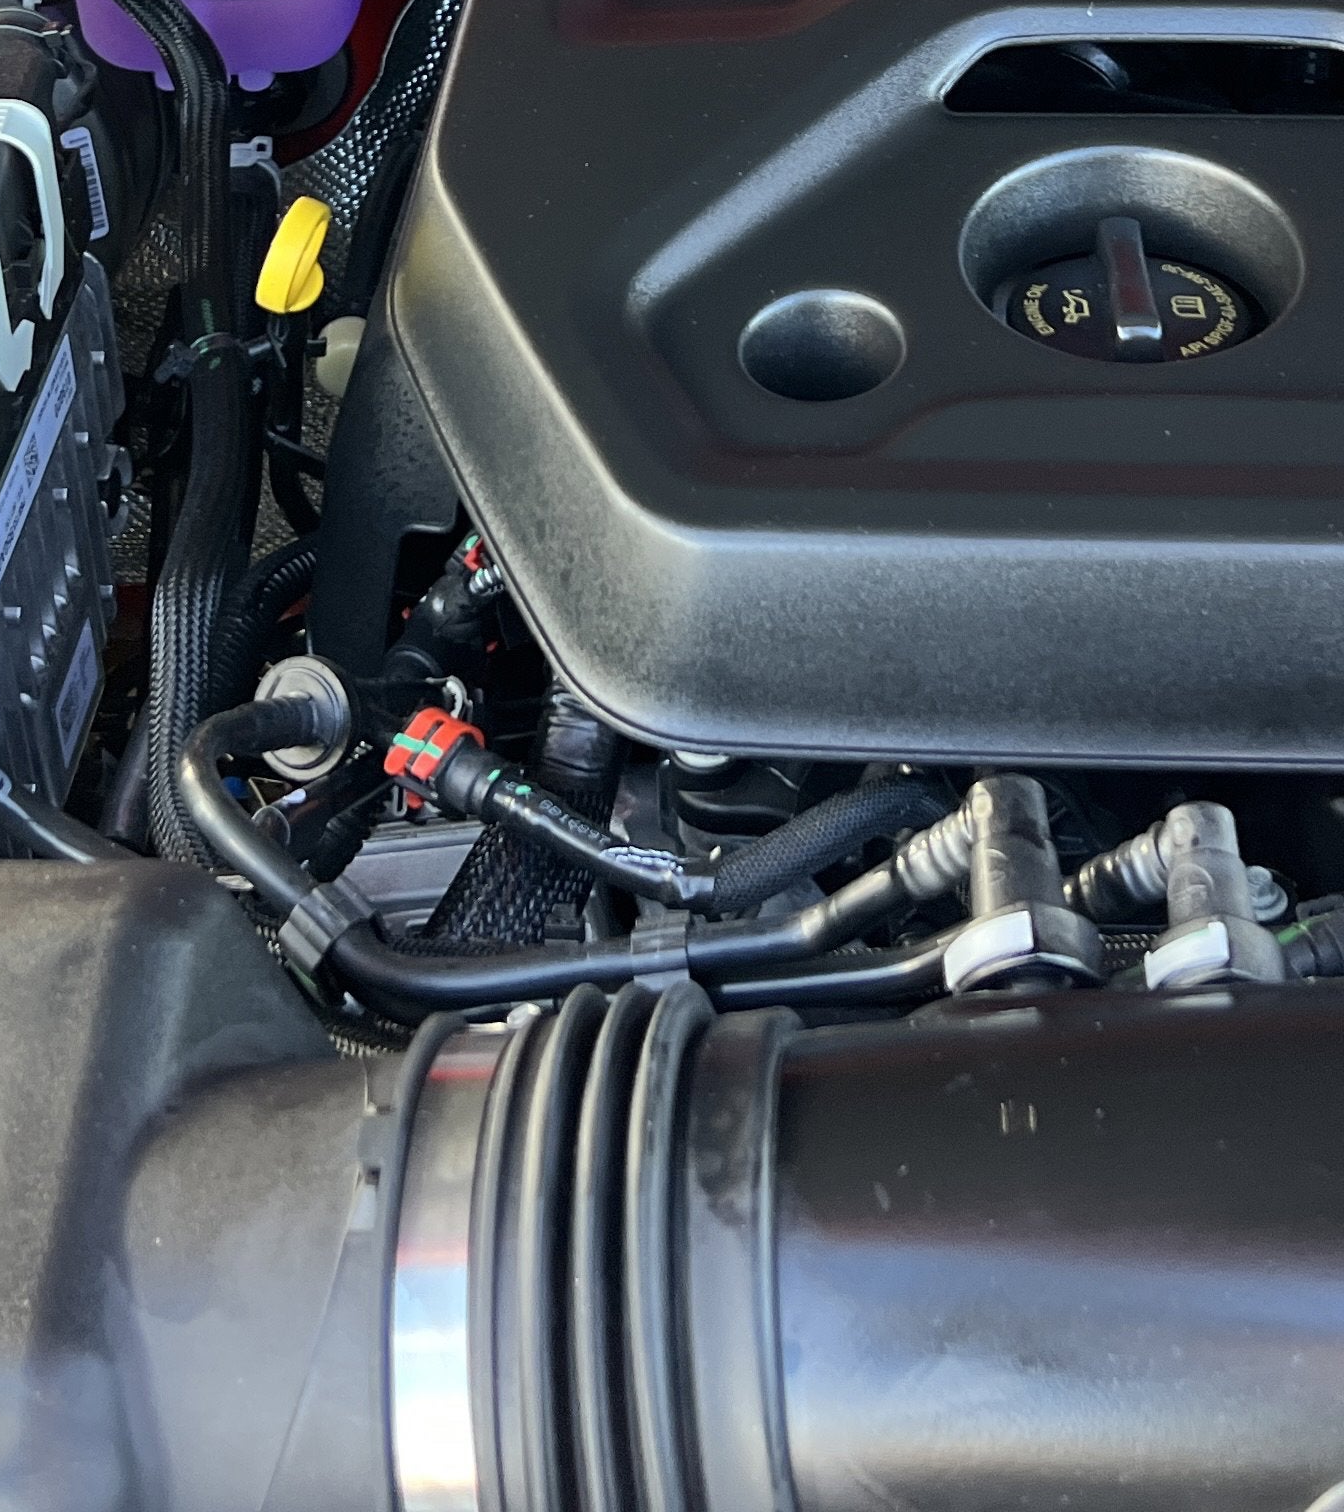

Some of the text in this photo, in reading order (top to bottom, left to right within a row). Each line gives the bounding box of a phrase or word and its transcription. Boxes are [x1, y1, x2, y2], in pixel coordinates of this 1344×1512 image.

[1023, 283, 1055, 337] ENGINE OIL
[1179, 340, 1210, 358] API
